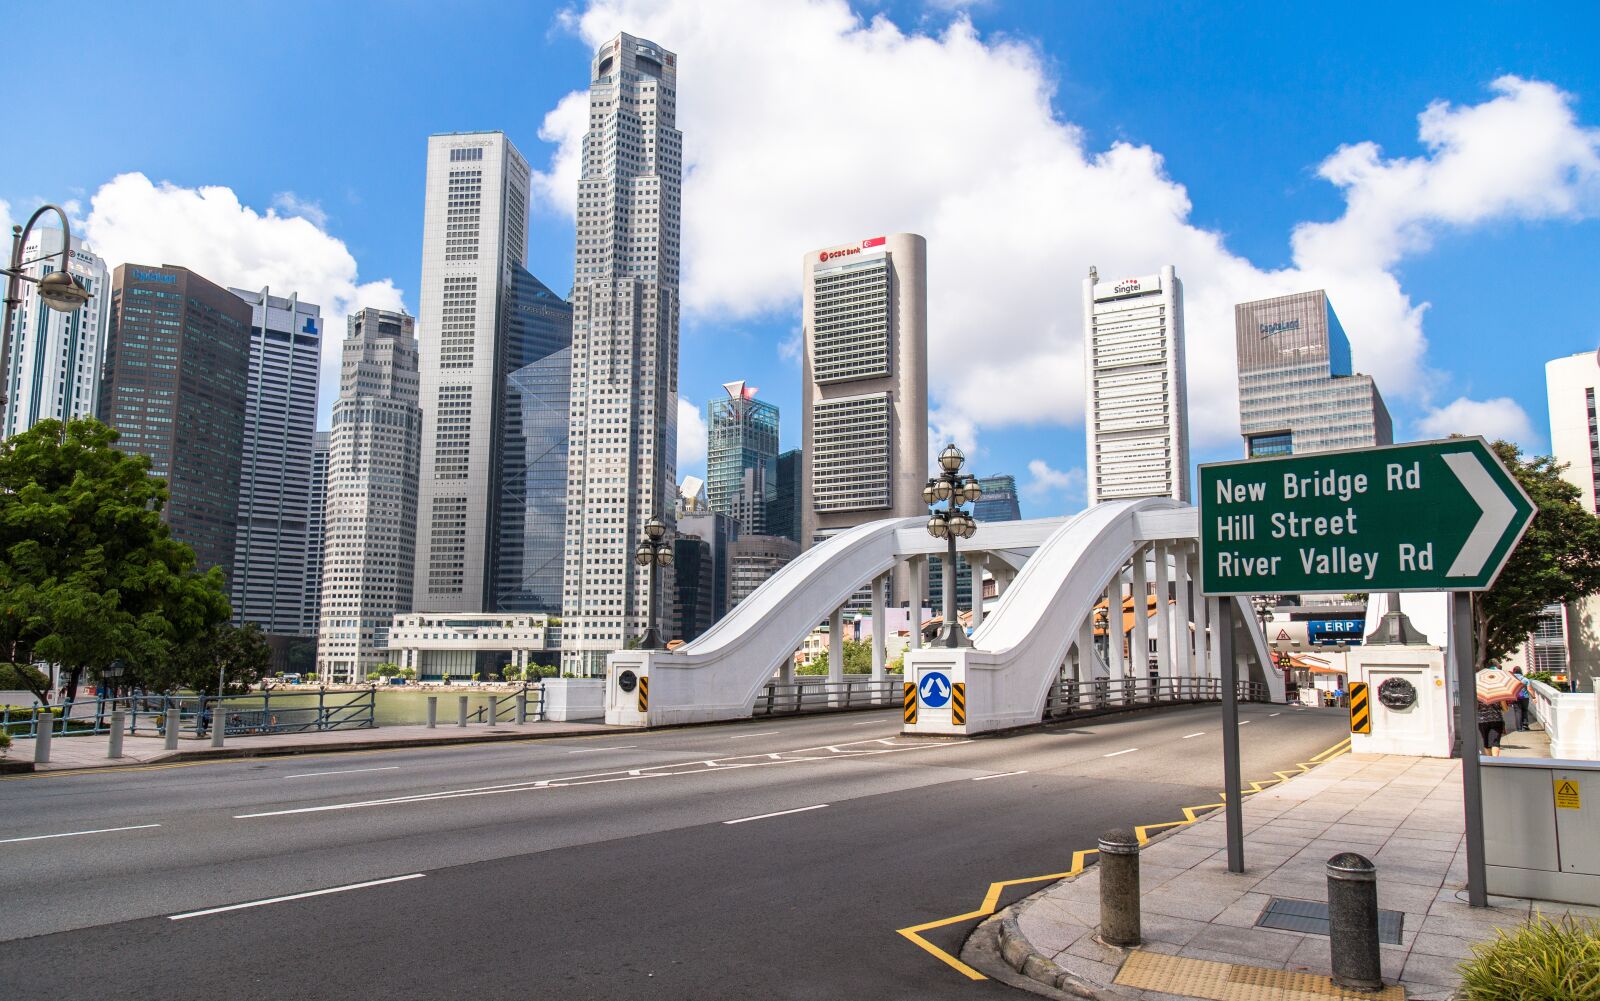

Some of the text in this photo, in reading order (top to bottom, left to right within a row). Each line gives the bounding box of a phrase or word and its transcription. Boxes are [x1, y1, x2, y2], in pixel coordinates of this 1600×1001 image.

[829, 247, 861, 259] OCBC Bank
[1114, 284, 1141, 294] Singtel
[1216, 461, 1421, 504] New Bridge Rd
[1217, 507, 1358, 542] Hill Street
[1218, 542, 1434, 580] River Valley Rd
[1324, 621, 1355, 632] ERP
